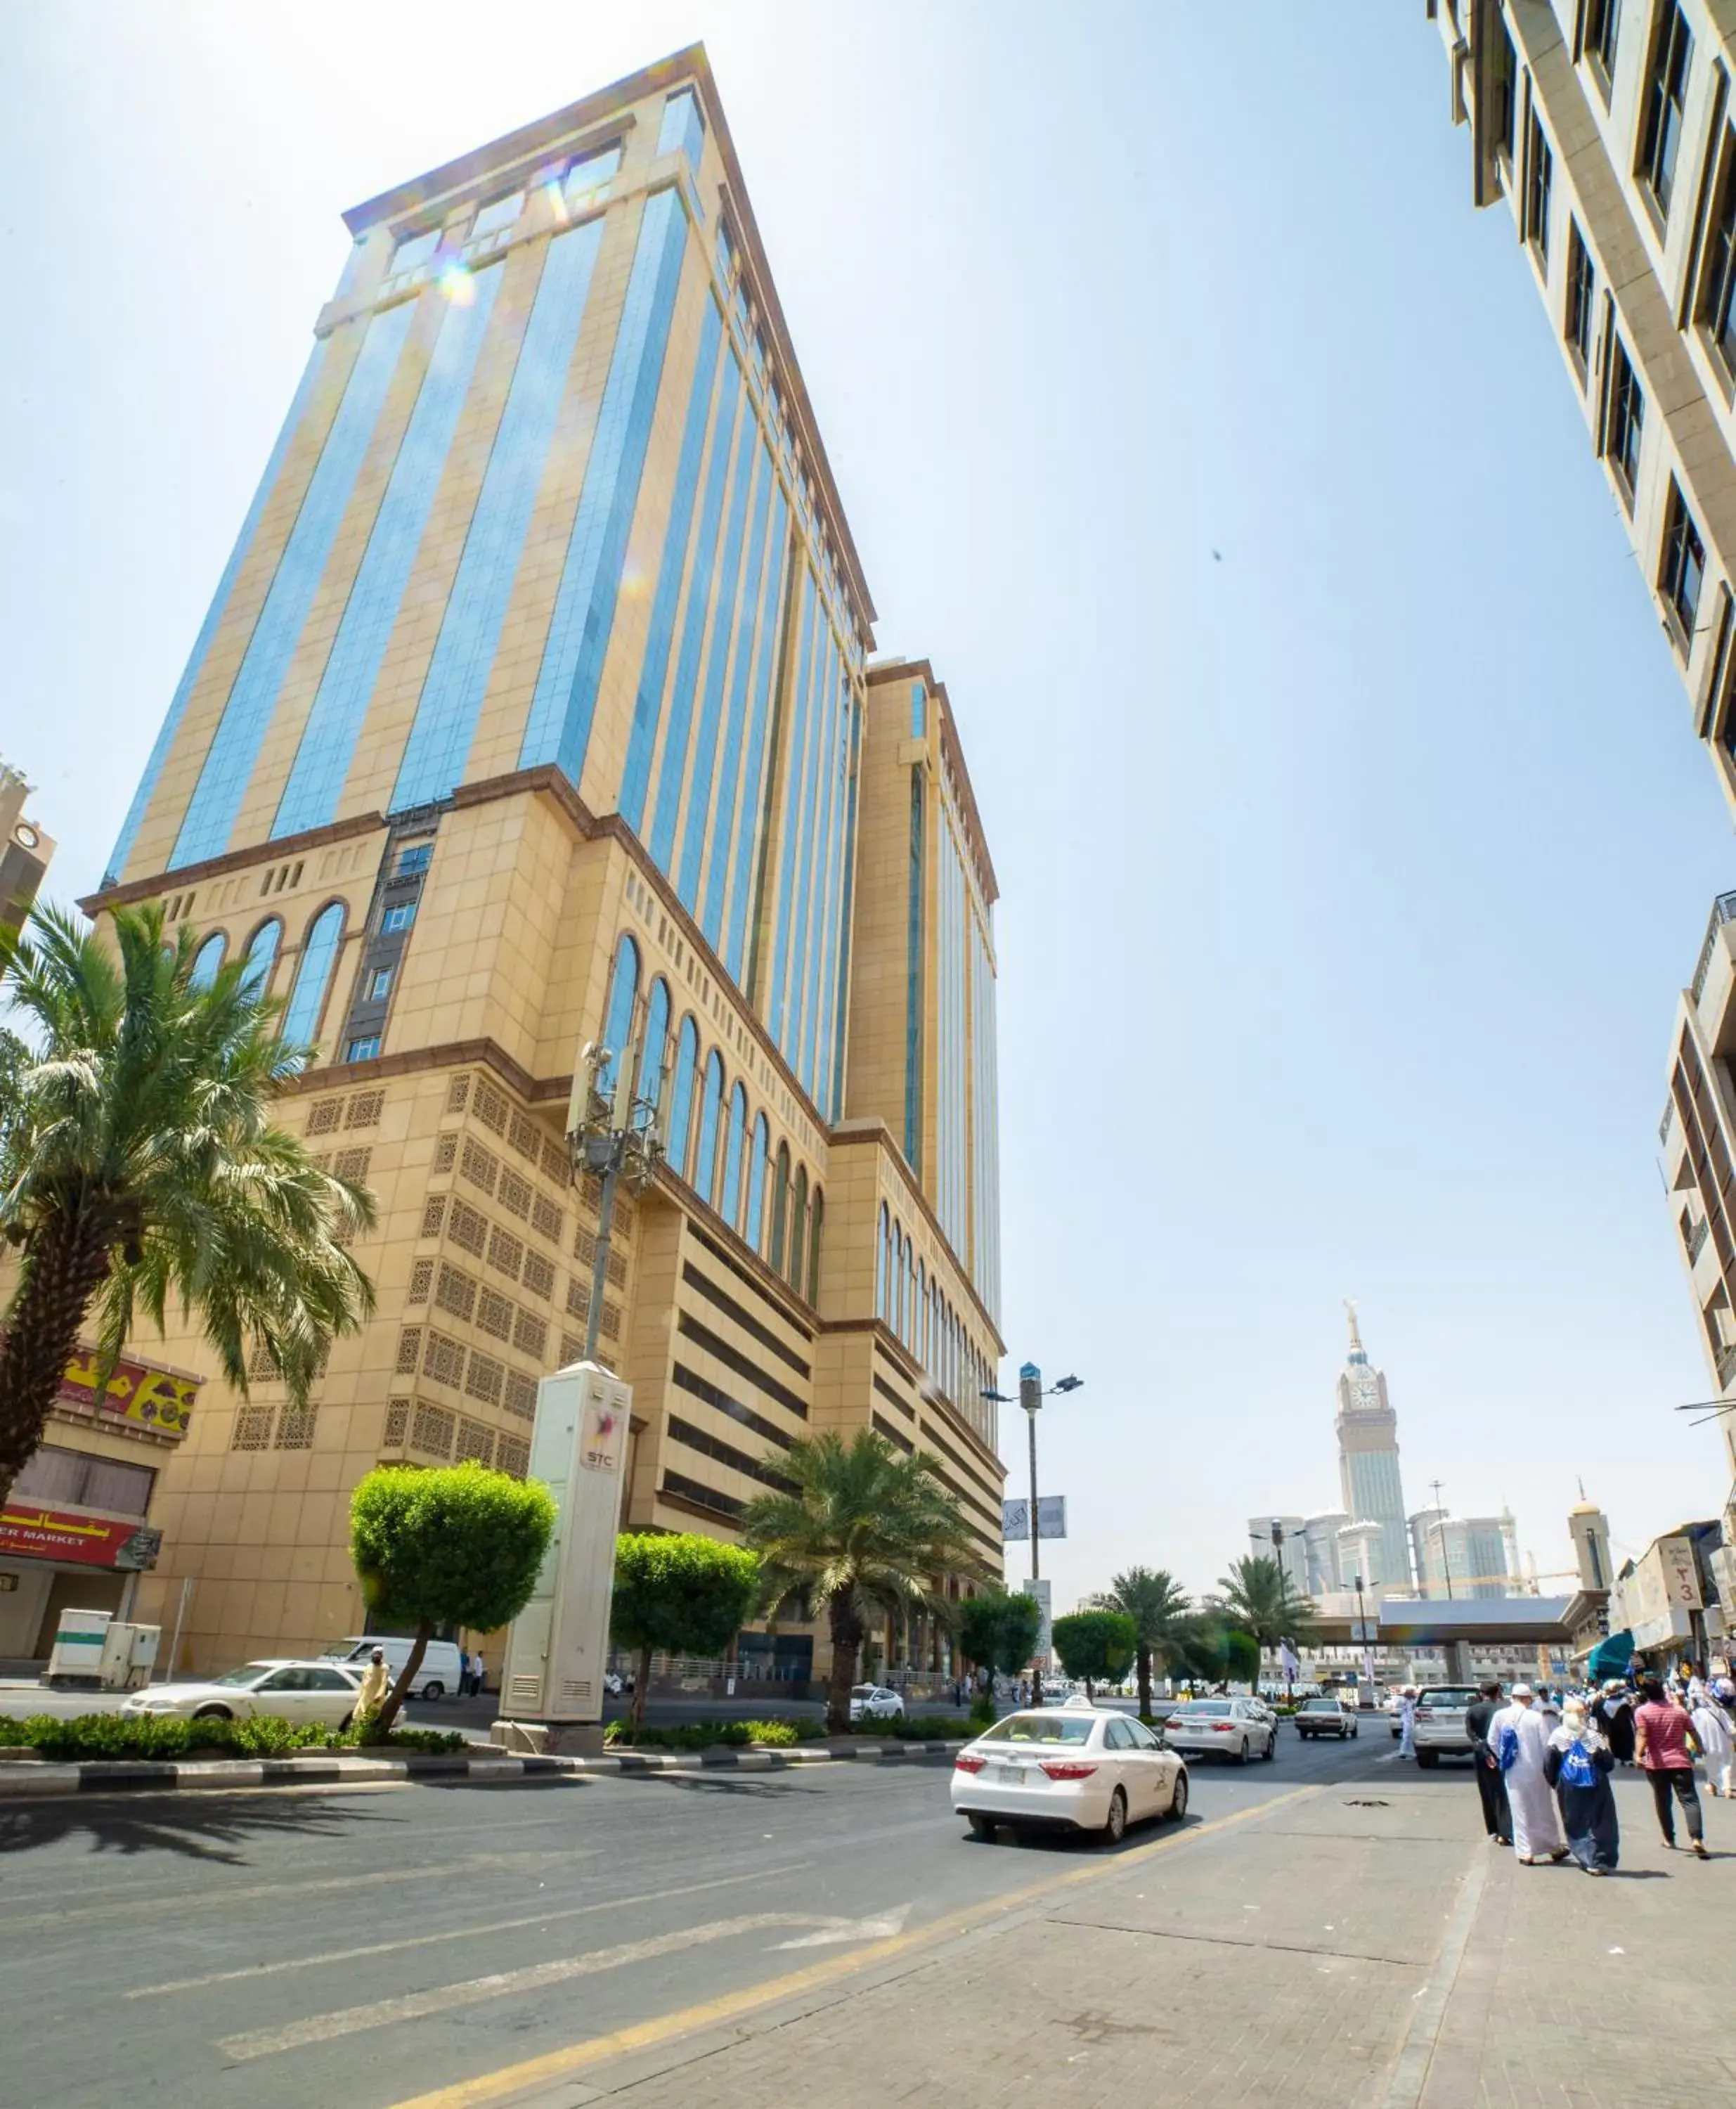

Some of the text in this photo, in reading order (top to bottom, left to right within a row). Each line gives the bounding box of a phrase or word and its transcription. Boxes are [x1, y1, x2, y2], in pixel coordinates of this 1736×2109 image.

[588, 1451, 614, 1467] STC
[0, 1512, 110, 1540] بقال
[23, 1530, 86, 1546] MARKET
[1680, 1583, 1694, 1601] 3
